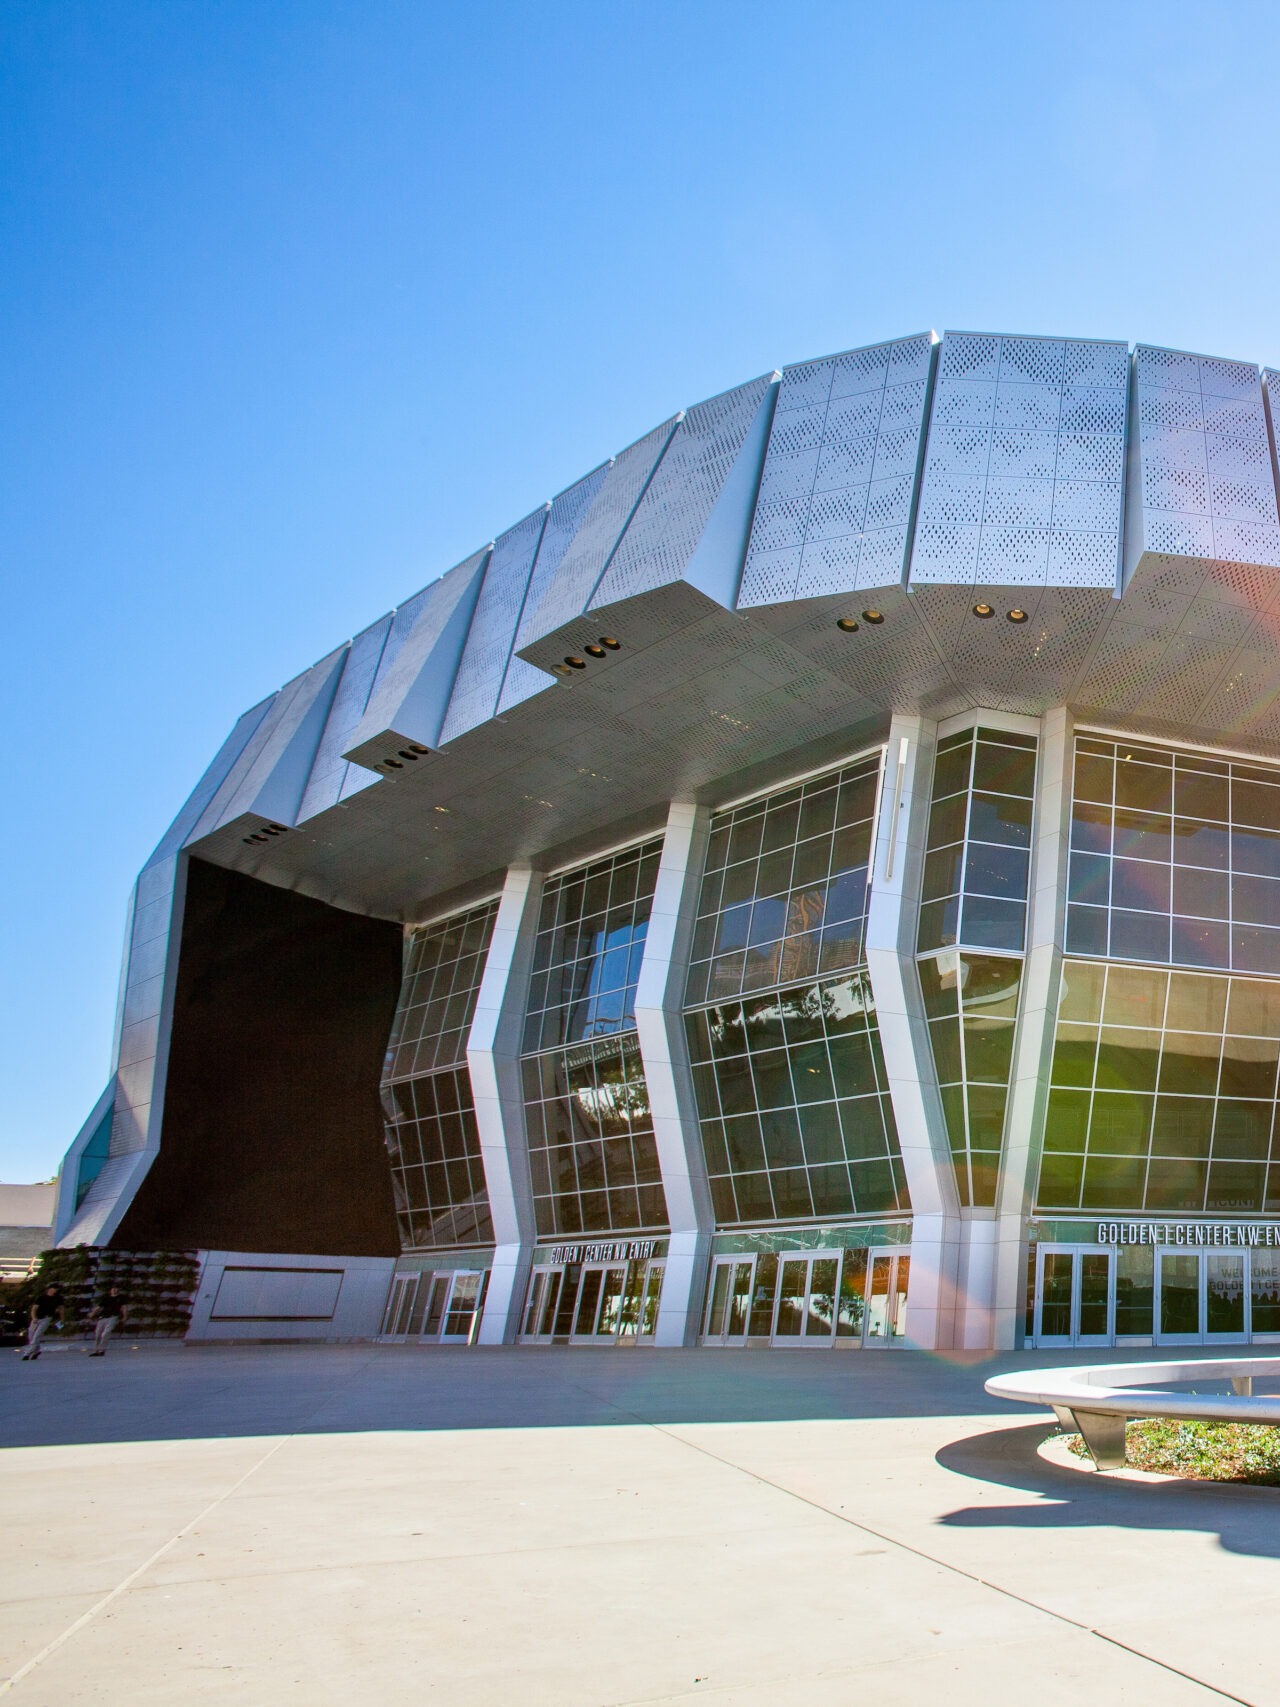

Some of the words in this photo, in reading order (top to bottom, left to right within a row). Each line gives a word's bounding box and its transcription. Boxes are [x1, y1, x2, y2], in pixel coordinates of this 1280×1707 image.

[1098, 1223, 1158, 1245] GOLDEN
[1163, 1224, 1169, 1245] 1
[1175, 1224, 1231, 1246] CENTER
[1237, 1225, 1259, 1246] NW
[550, 1246, 579, 1264] GOLDEN
[584, 1243, 614, 1262] CENTER
[613, 1242, 629, 1260] NW
[628, 1241, 656, 1260] ENTRY
